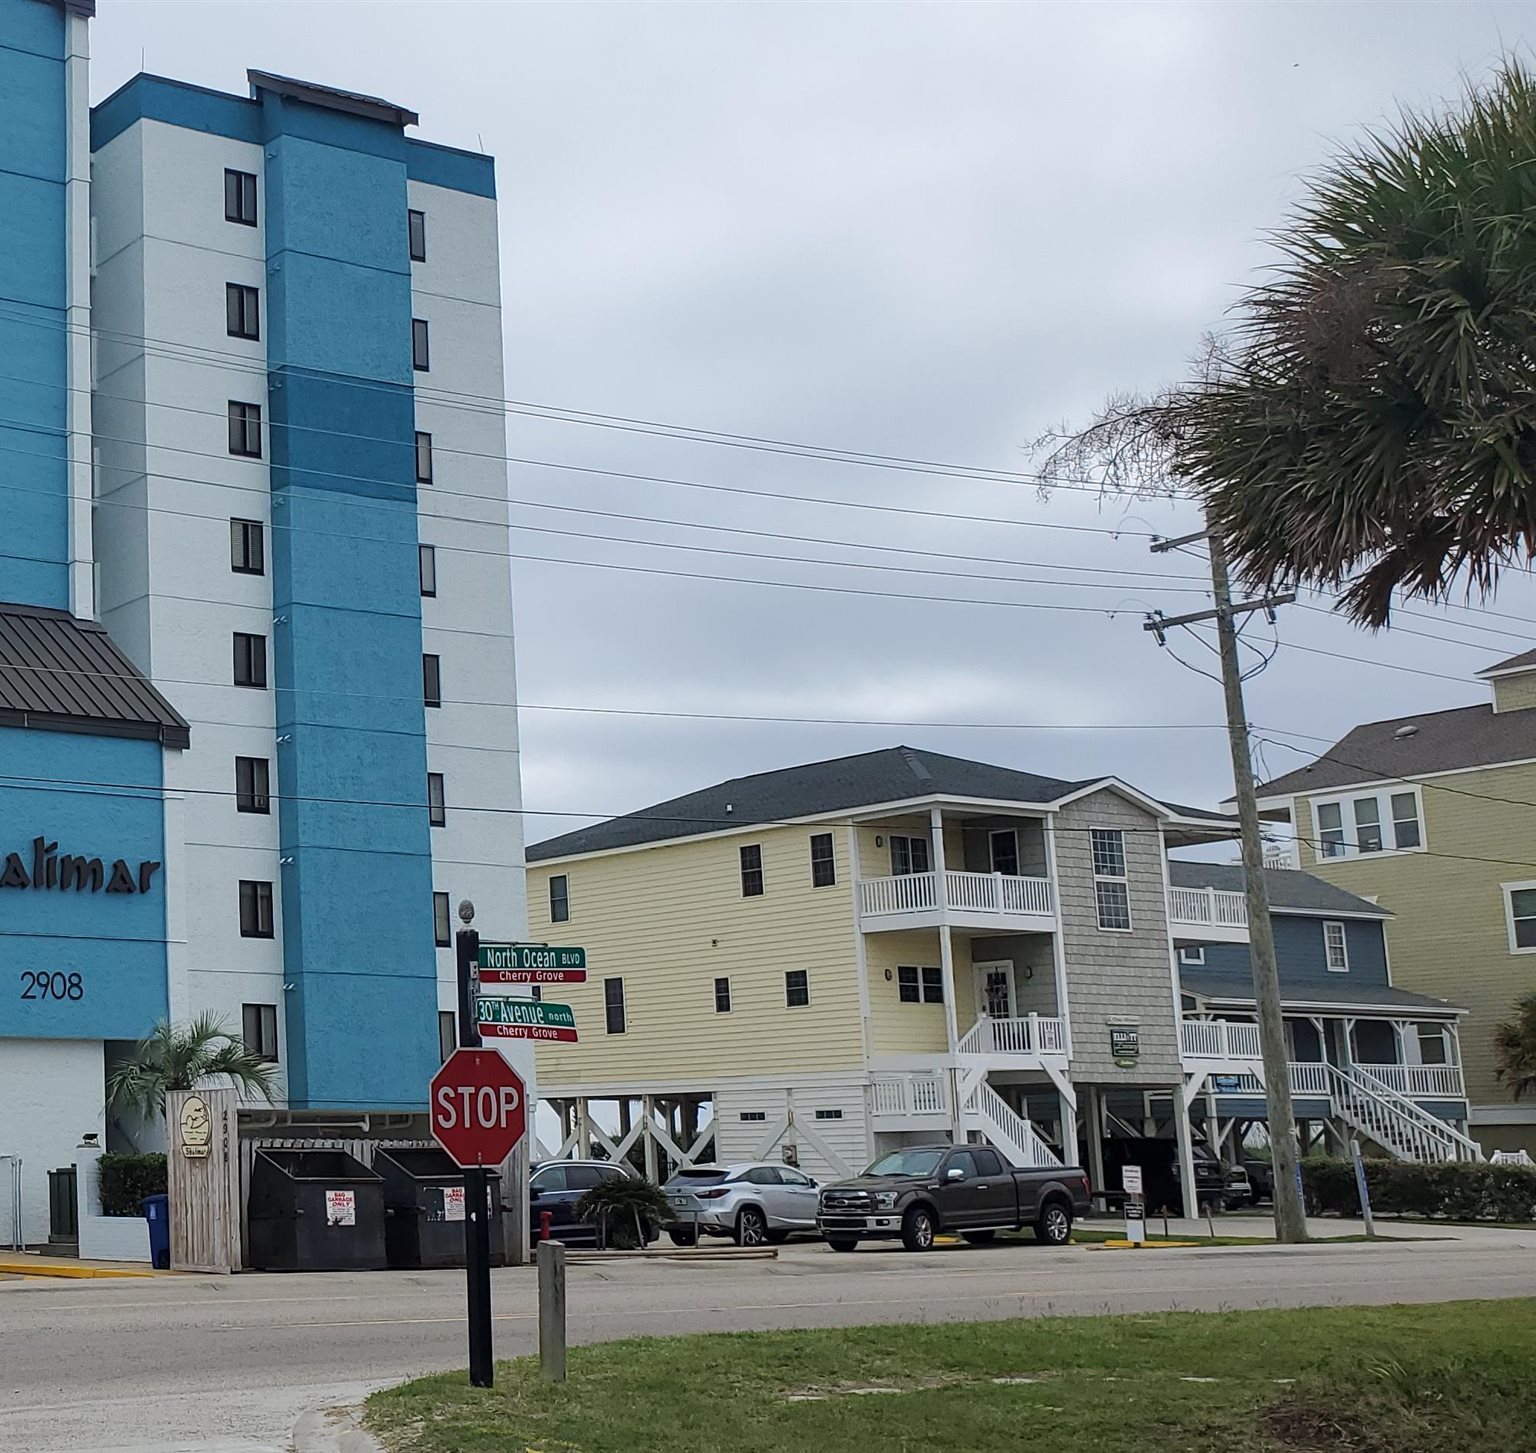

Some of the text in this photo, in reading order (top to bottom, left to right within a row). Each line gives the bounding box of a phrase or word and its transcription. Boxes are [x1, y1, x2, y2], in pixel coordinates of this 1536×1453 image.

[487, 948, 580, 968] North Ocean BLVD
[20, 971, 84, 1001] 2908
[499, 970, 564, 982] Cherry Grove
[500, 1002, 545, 1024] Avenue
[548, 1011, 573, 1023] north
[496, 1025, 558, 1039] Cherry Grove
[437, 1086, 519, 1129] STOP
